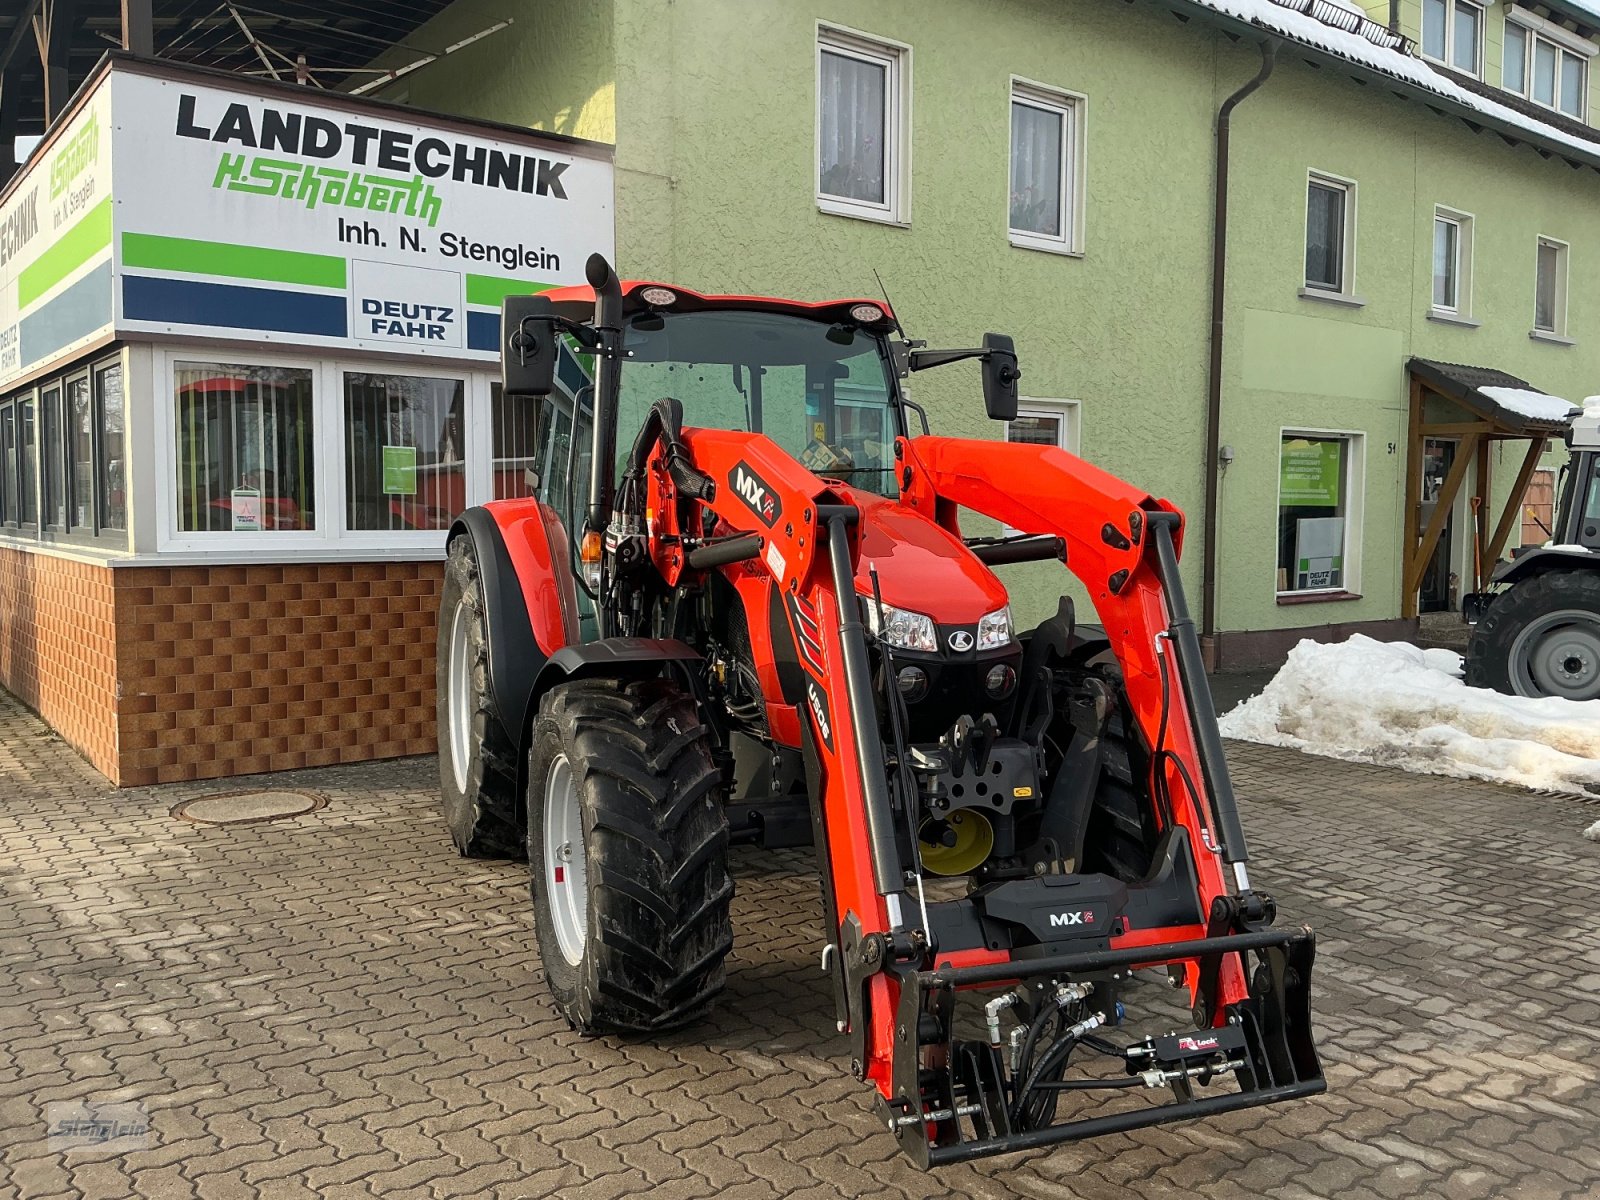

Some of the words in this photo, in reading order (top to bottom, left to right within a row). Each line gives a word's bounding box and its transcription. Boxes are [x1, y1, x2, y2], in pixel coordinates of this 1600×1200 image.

[176, 94, 570, 200] LANDTECHNIK
[338, 217, 386, 247] Inh.
[400, 226, 426, 253] N.
[440, 232, 560, 271] Stenglein
[362, 298, 454, 323] DEUTZ
[372, 318, 446, 340] FAHR
[736, 466, 765, 513] MX
[1310, 570, 1330, 579] DEUTZ
[1049, 911, 1083, 927] MX
